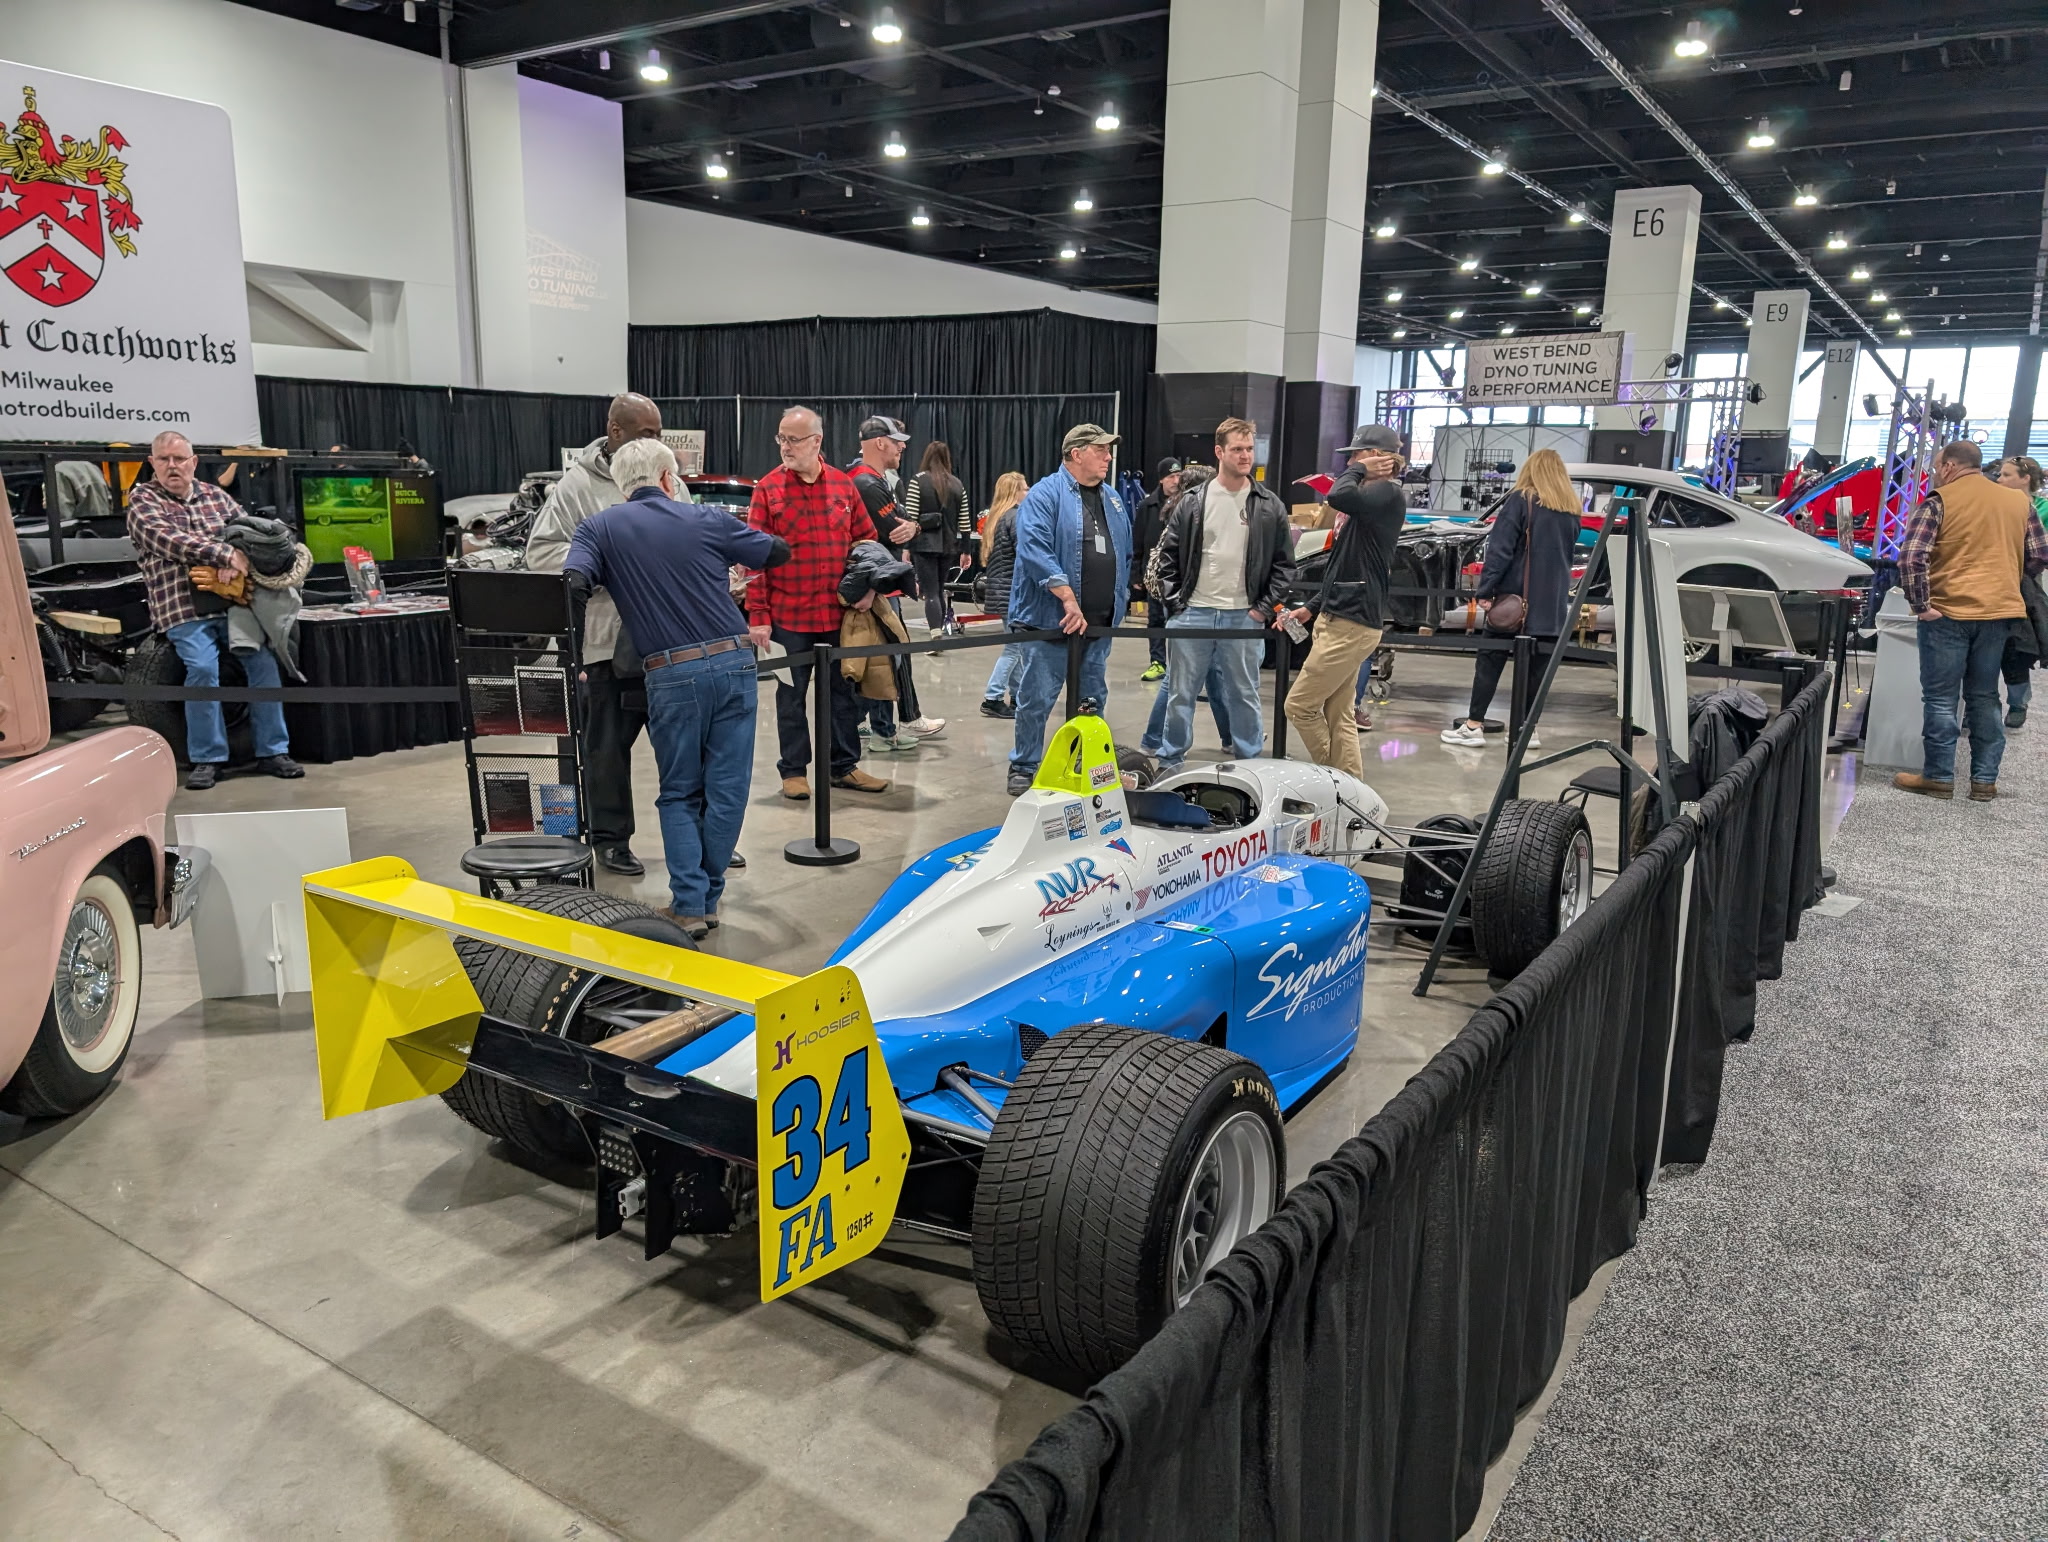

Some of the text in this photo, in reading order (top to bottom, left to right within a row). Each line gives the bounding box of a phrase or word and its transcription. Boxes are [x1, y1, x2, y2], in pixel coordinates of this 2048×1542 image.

[1633, 207, 1665, 237] E6
[541, 278, 596, 298] TUNING
[1766, 303, 1789, 323] E9
[26, 318, 236, 364] Coachworks
[1493, 343, 1591, 361] WEST BEND
[1827, 347, 1853, 364] E12
[1, 371, 114, 393] Milwaukee
[1484, 361, 1598, 379] DYNO TUNING
[1468, 379, 1612, 397] & PERFORMANCE
[1090, 763, 1114, 777] TOYOTA
[1156, 842, 1194, 868] ATLANTIC
[1201, 829, 1268, 882] TOYOTA
[1034, 857, 1112, 904] NVR
[1152, 868, 1202, 902] YOKOHAMA
[1044, 922, 1101, 952] Loynings
[1303, 974, 1359, 1016] PRODUCTION
[796, 1010, 861, 1050] HOOSIER
[772, 1045, 872, 1211] 34
[846, 1210, 874, 1241] 1250#
[773, 1192, 837, 1291] FA
